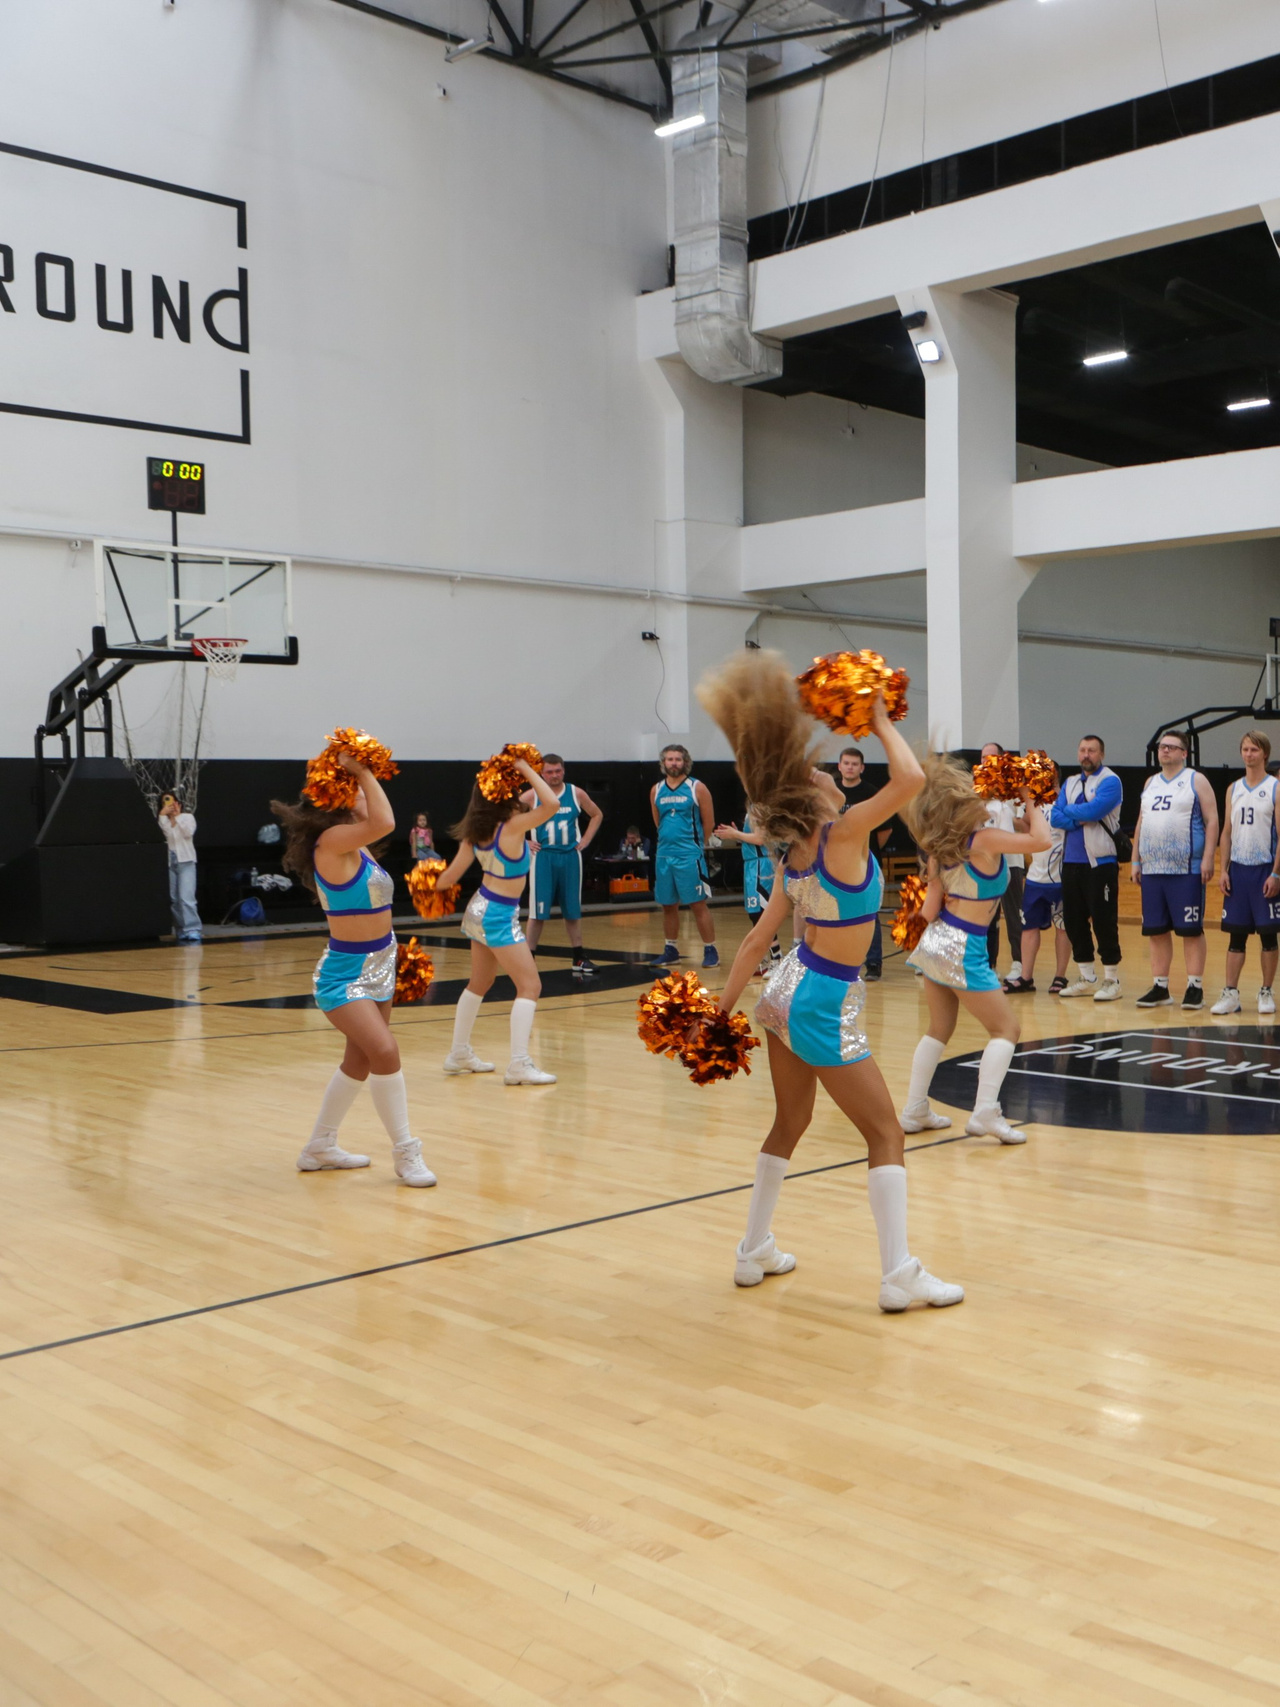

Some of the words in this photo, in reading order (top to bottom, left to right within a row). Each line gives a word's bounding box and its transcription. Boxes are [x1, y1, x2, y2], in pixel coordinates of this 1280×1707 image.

[1151, 795, 1173, 811] 25
[1240, 807, 1254, 825] 13
[545, 820, 569, 846] 11
[1184, 906, 1200, 923] 25
